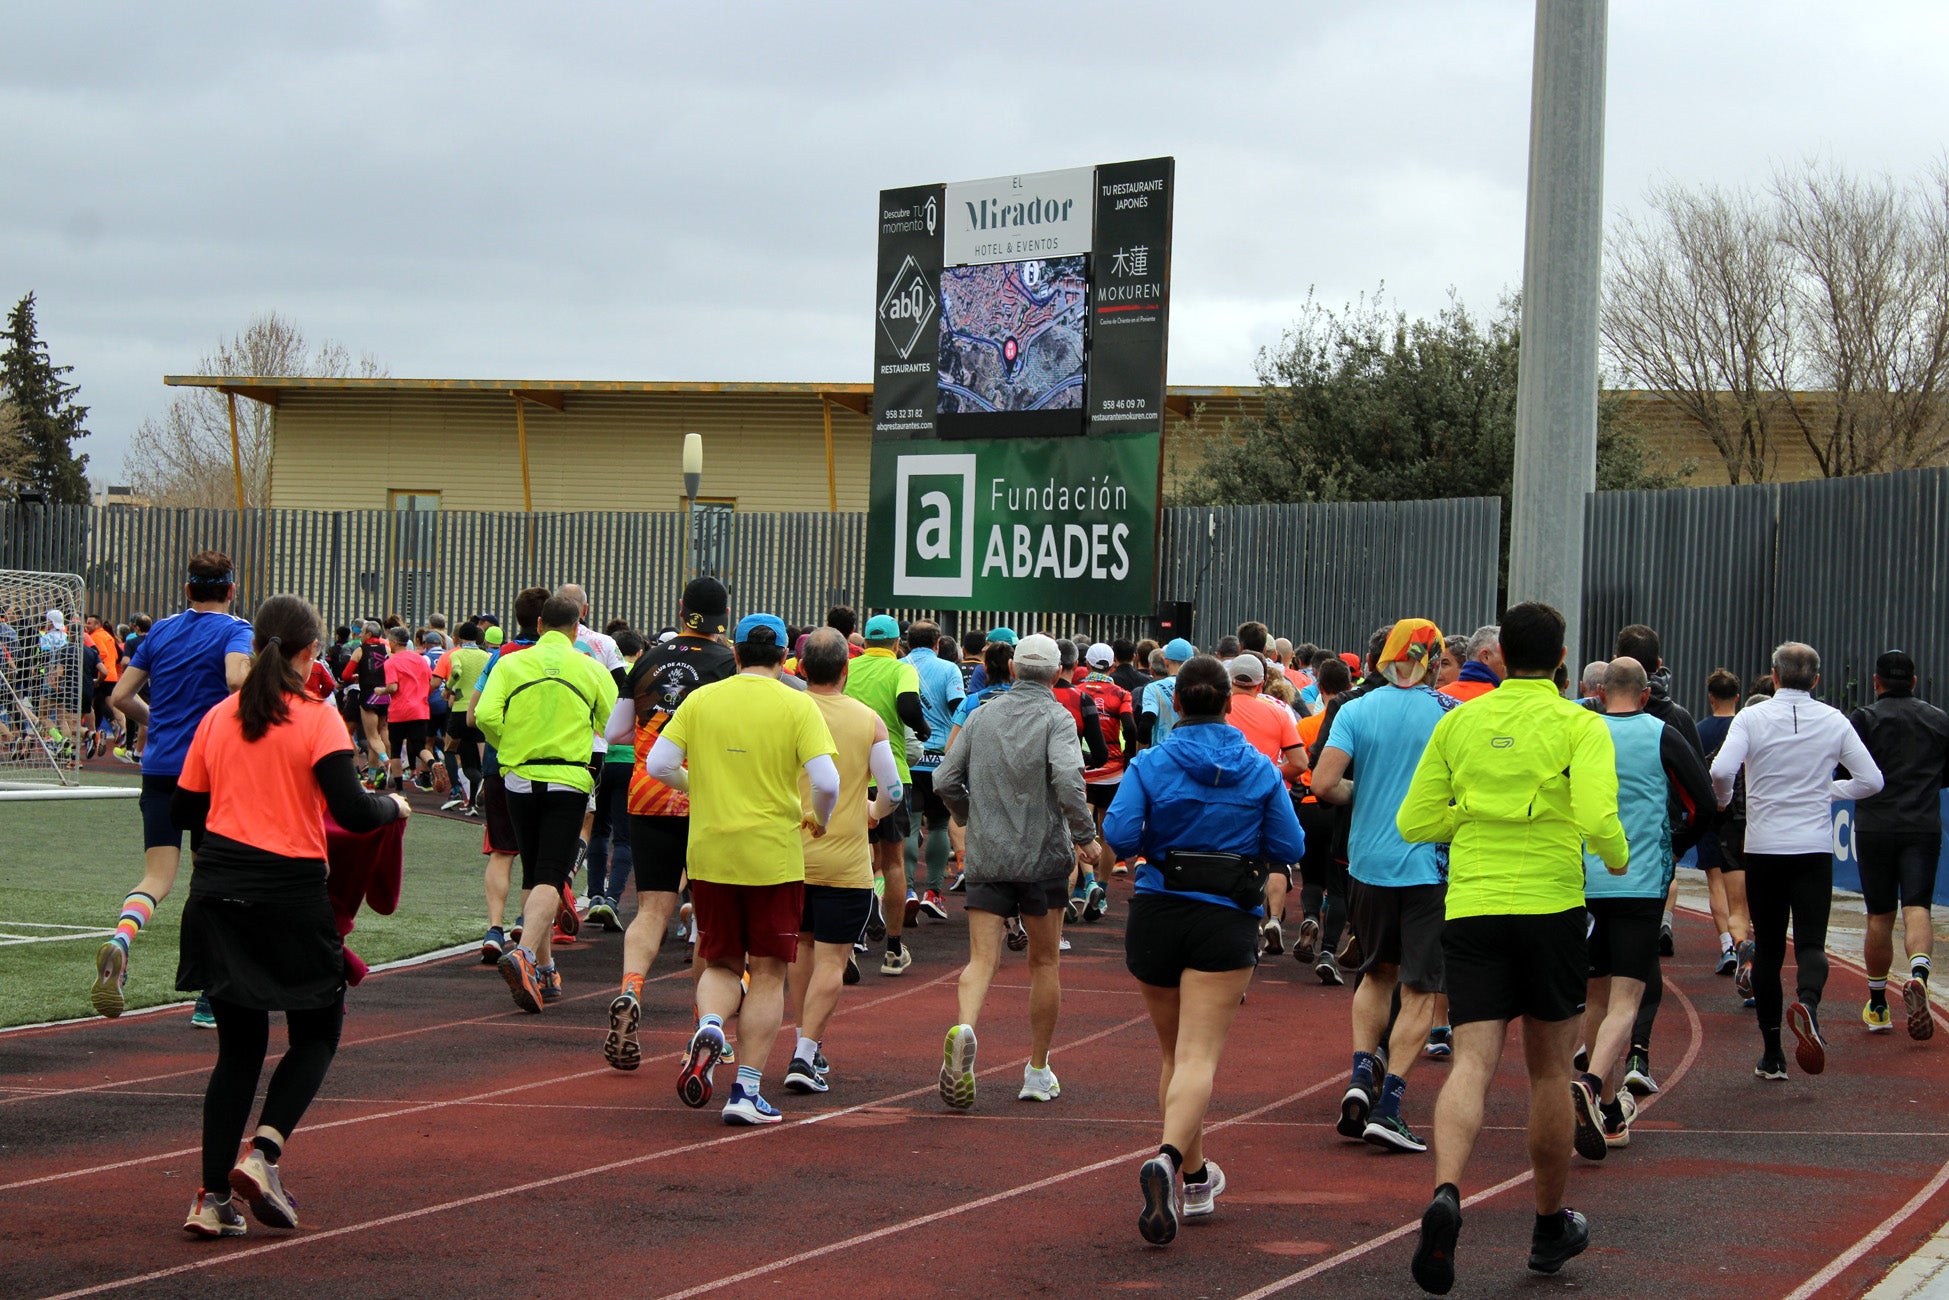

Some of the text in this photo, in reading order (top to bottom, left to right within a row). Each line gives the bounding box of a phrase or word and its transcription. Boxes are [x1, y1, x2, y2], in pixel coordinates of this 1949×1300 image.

[1012, 176, 1023, 188] EL
[1102, 180, 1163, 196] TU RESTAURANTE
[1115, 195, 1148, 210] JAPONÉS
[884, 205, 924, 219] Descubre TU
[965, 193, 1073, 231] Mirador
[883, 219, 924, 233] momento
[975, 237, 1059, 256] HOTEL & EVENTOS
[1111, 245, 1148, 277] 木蓮
[1098, 284, 1160, 301] MOKUREN
[881, 363, 930, 374] RESTAURANTES
[1103, 399, 1145, 409] 958 46 09 70
[886, 409, 922, 419] 958 32 31 82
[1092, 411, 1158, 421] restaurantemokuren.com
[877, 422, 933, 431] abqrestaurantes.com
[992, 476, 1126, 511] Fundación
[981, 522, 1130, 581] ABADES
[653, 664, 667, 677] CLUB
